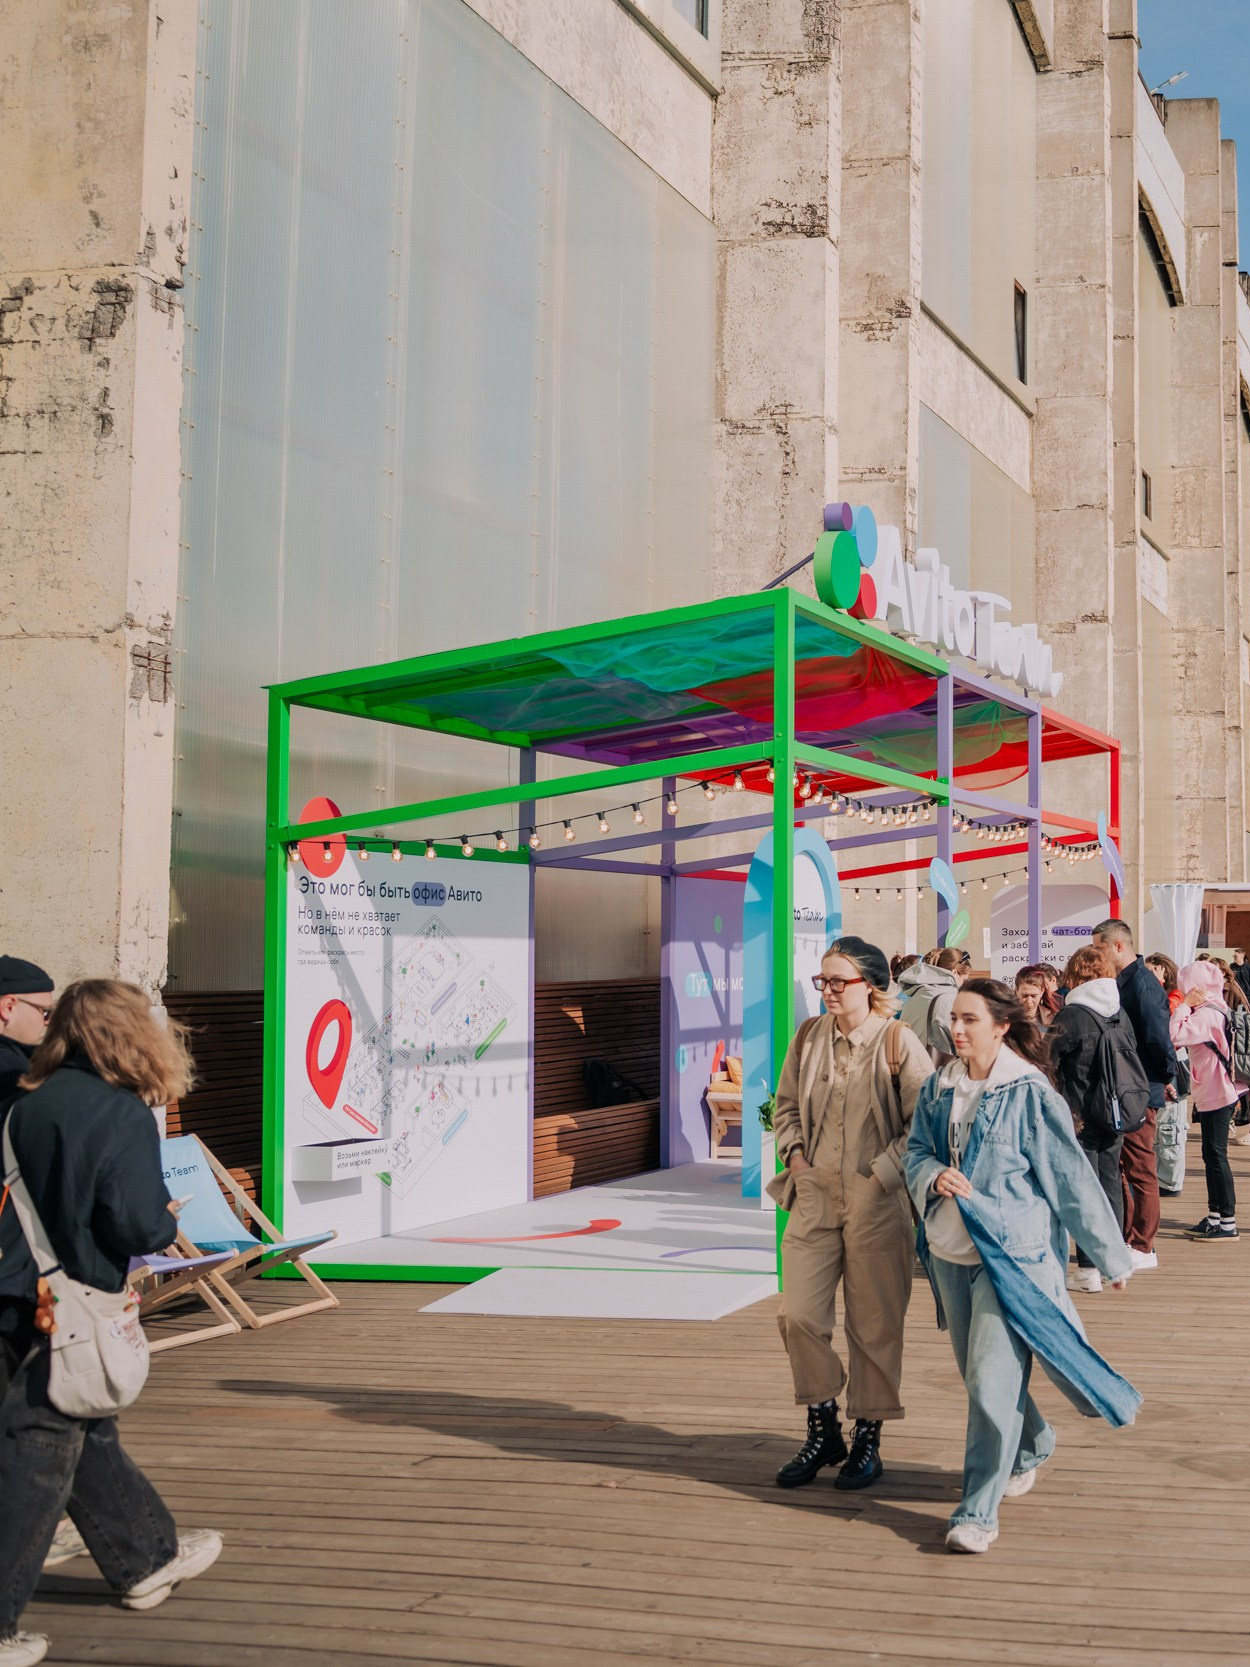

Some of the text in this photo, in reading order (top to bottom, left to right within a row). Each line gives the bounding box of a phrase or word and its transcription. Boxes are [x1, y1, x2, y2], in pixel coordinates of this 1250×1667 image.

[300, 876, 482, 904] Это мог бы быть офис Авито
[298, 906, 400, 922] Но в нём не хватает
[298, 924, 392, 939] команды и красок
[1010, 940, 1054, 949] забай
[689, 973, 743, 997] Тут мы мо
[171, 1164, 199, 1176] Team
